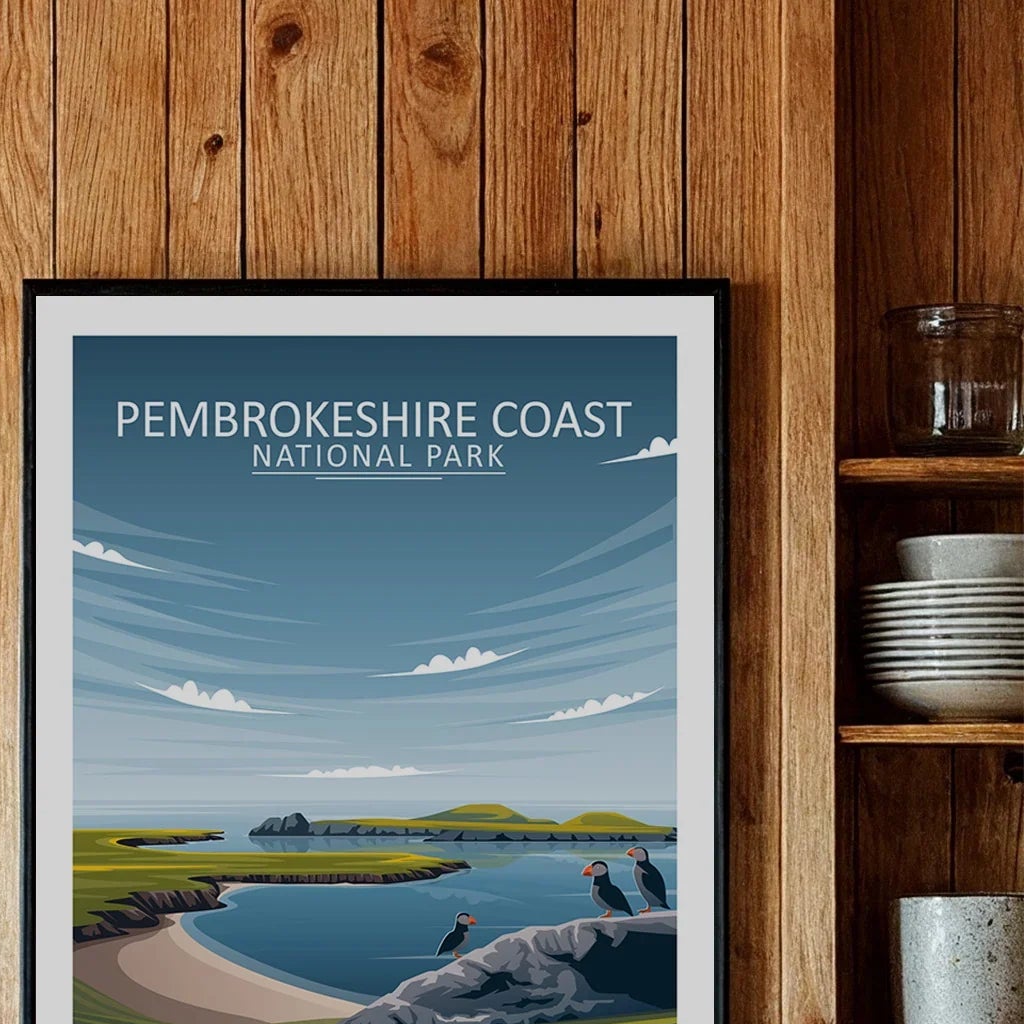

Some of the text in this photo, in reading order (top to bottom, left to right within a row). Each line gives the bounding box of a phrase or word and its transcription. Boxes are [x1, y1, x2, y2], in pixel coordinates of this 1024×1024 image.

[117, 401, 632, 437] PEMBROKESHIRE COAST
[253, 444, 504, 467] NATIONAL PARK
